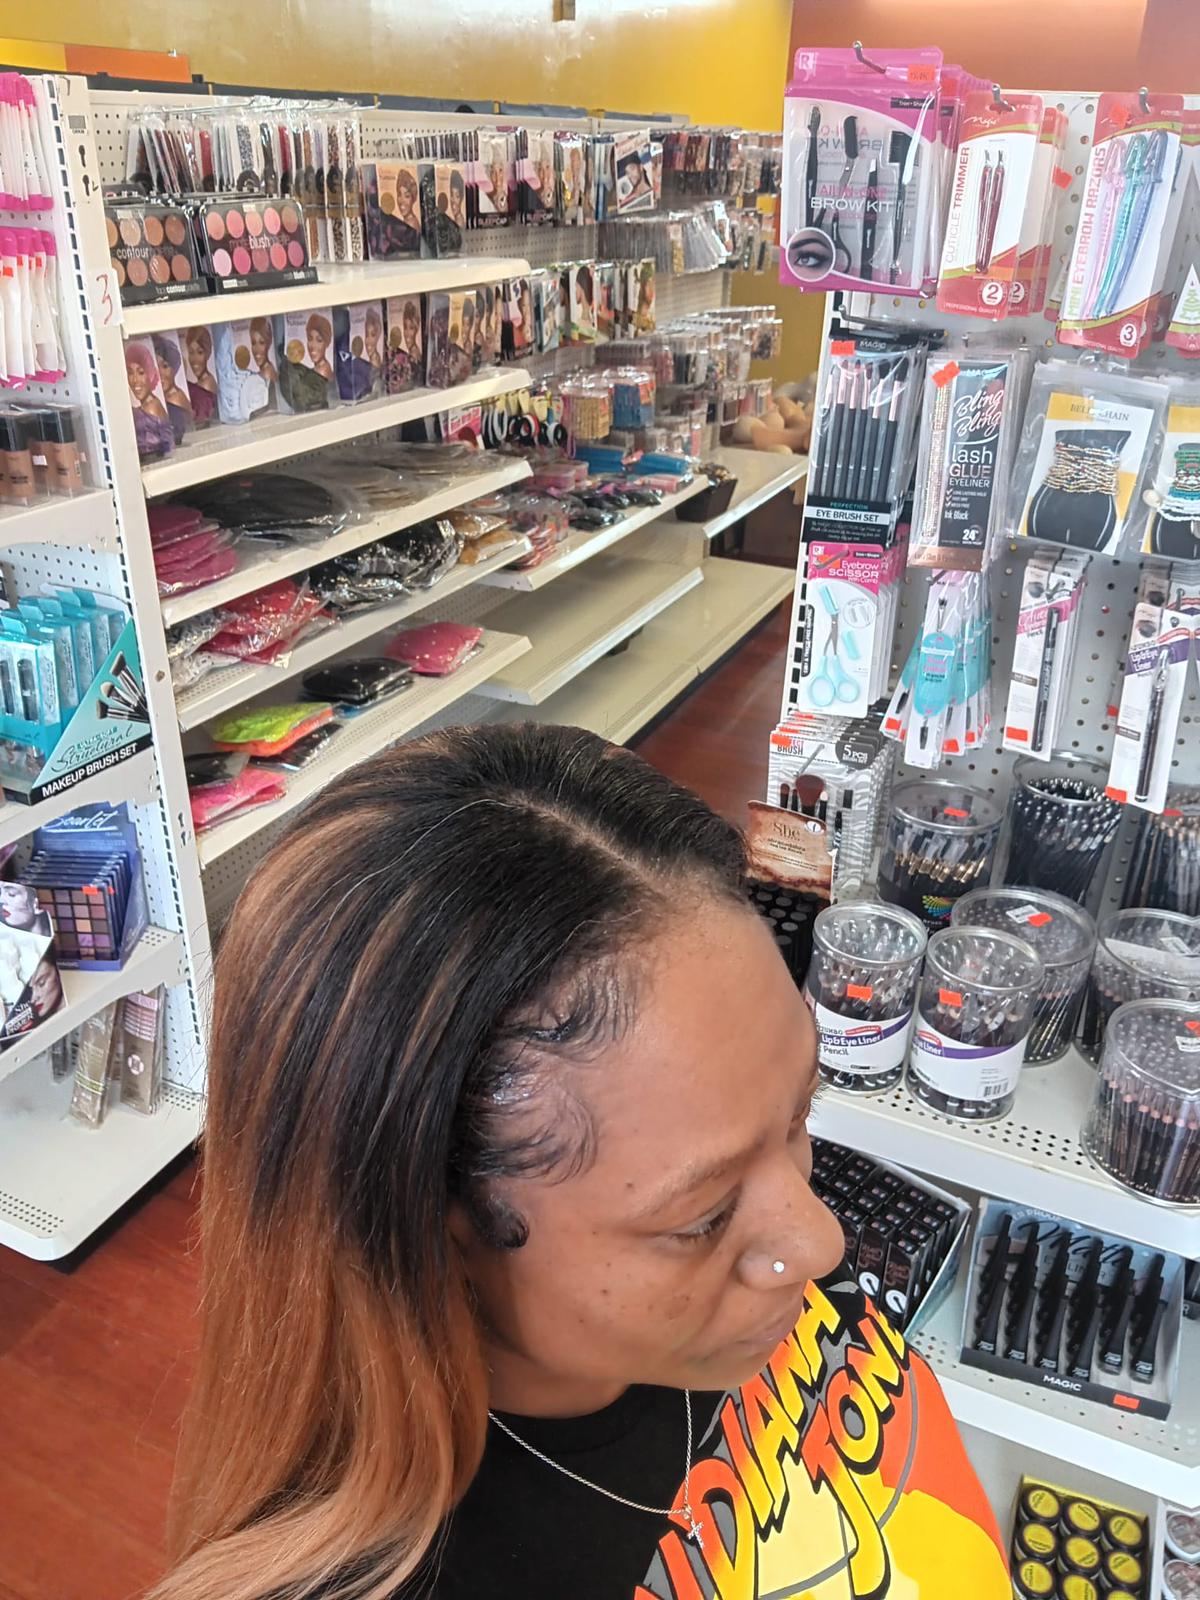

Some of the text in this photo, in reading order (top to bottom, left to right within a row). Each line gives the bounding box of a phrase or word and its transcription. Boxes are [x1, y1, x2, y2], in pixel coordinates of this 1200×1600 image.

[954, 147, 970, 209] TRIMMER
[811, 197, 894, 213] BROW KIT
[1072, 147, 1107, 285] EYEBROW RAZORS
[249, 233, 272, 250] blush
[945, 210, 961, 263] CUTICLE
[116, 246, 149, 260] contour
[166, 284, 186, 294] contour
[985, 284, 999, 300] 2
[1123, 325, 1135, 342] 3
[859, 340, 887, 350] MAGIC
[953, 389, 1005, 417] Bling
[953, 411, 1002, 438] Bling
[952, 444, 993, 465] lash
[949, 463, 992, 479] GLUE
[949, 478, 991, 488] EYELINER
[830, 501, 869, 510] PERFECTION
[816, 509, 880, 523] EYE BRUSH SET
[828, 568, 880, 579] SCISSOR
[841, 560, 880, 572] Eyebrow
[844, 744, 869, 760] 5 PCS
[41, 743, 138, 797] MAKEUP BRUSH SET
[858, 1033, 881, 1046] Liner
[823, 1046, 849, 1056] Pencil
[1042, 1375, 1083, 1392] MAGIC
